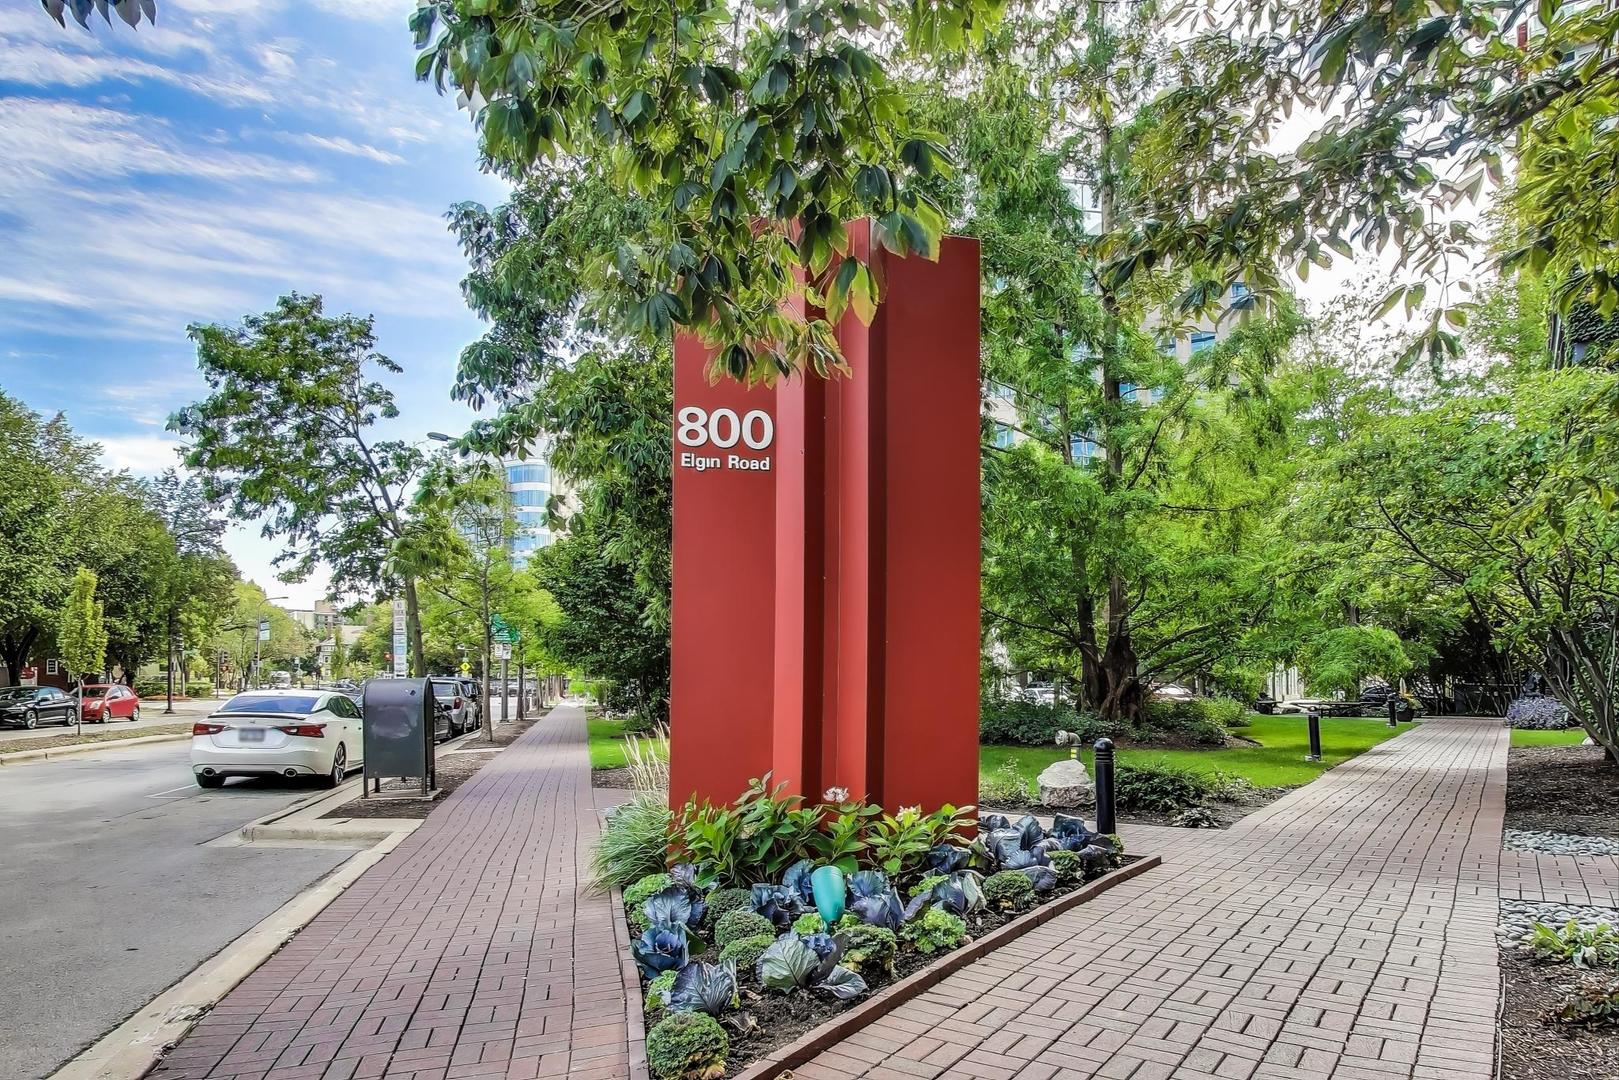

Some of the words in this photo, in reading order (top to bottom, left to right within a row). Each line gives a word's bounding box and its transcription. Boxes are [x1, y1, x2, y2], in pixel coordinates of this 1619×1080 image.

[677, 406, 774, 450] 800
[681, 452, 720, 471] Elgin
[728, 455, 770, 470] Road
